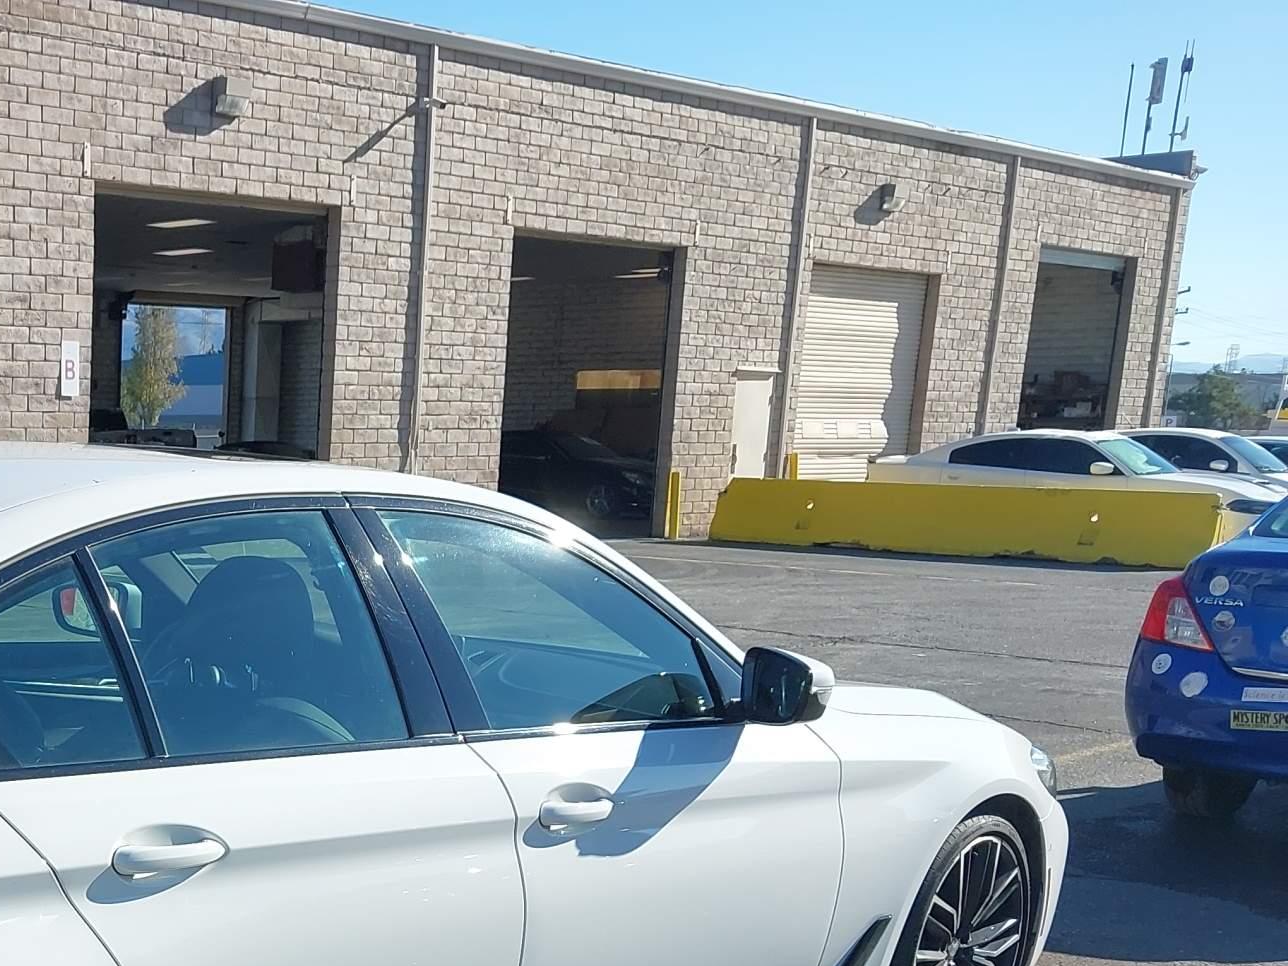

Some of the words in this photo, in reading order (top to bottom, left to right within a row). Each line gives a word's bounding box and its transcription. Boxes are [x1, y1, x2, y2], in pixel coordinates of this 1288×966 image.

[65, 359, 77, 381] B
[1195, 595, 1245, 608] VERSA
[1232, 711, 1272, 724] MYSTERY
